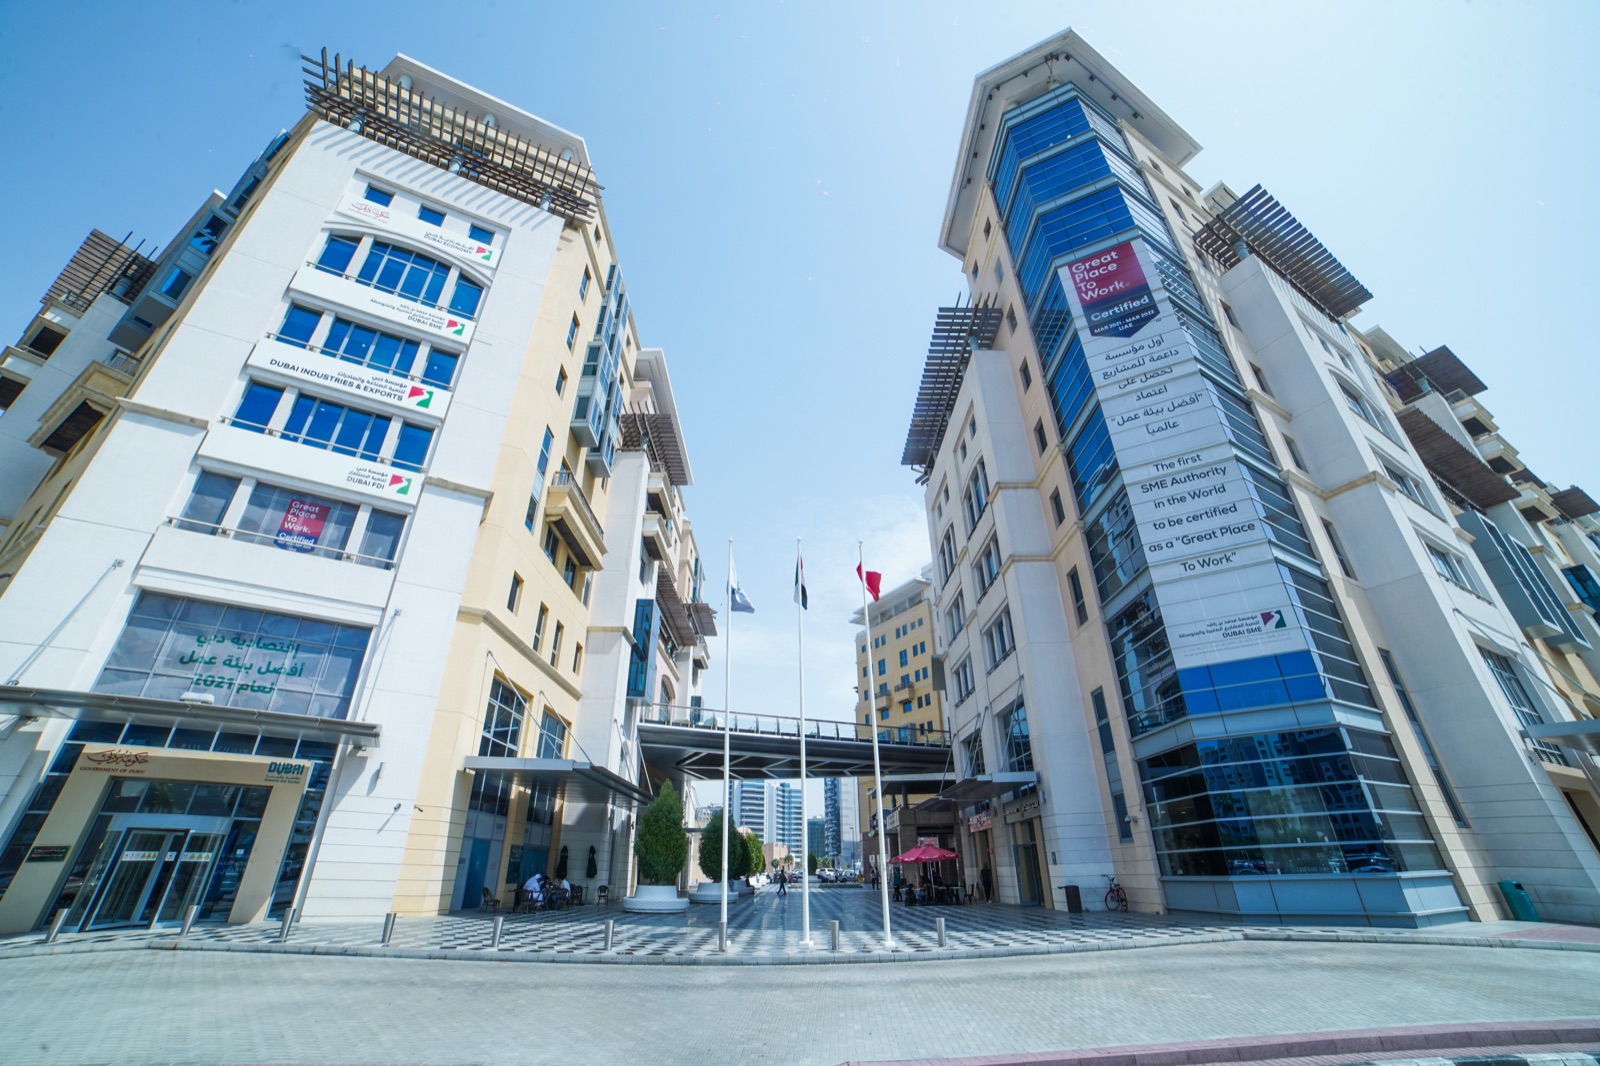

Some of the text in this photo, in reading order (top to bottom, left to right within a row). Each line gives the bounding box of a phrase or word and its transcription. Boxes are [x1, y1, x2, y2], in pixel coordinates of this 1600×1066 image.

[424, 235, 472, 254] DUBAI ECONOMY
[1072, 251, 1118, 273] Great
[1075, 263, 1117, 283] Place
[1078, 281, 1096, 292] To
[1091, 295, 1149, 321] Certified
[408, 316, 442, 330] DUBAI SME
[1105, 345, 1144, 360] مؤسسة
[1102, 349, 1179, 380] داعمة للمشاريع
[270, 358, 299, 372] DUBAI
[300, 367, 354, 388] INDUSTRIES
[363, 384, 403, 401] EXPORTS
[1118, 366, 1173, 389] تحصل على
[1136, 384, 1168, 402] اعتماد
[1143, 407, 1164, 417] بيئة
[1153, 454, 1202, 472] The first
[346, 476, 385, 490] DUBAI FDI
[1140, 466, 1227, 494] SME Authority
[1154, 484, 1226, 509] in the World
[289, 508, 316, 519] Place
[292, 501, 319, 513] Great
[287, 514, 297, 523] To
[1153, 503, 1238, 530] to be certified
[279, 532, 314, 545] Certified
[1149, 542, 1163, 552] as
[1166, 540, 1174, 549] a
[1220, 522, 1256, 537] Place
[1180, 560, 1196, 572] To
[196, 633, 226, 647] دبي
[1223, 626, 1262, 638] DUBAI SME
[179, 650, 306, 677] أفضل بيئة عمل
[193, 673, 235, 690] 2021
[268, 761, 305, 775] DUBAI
